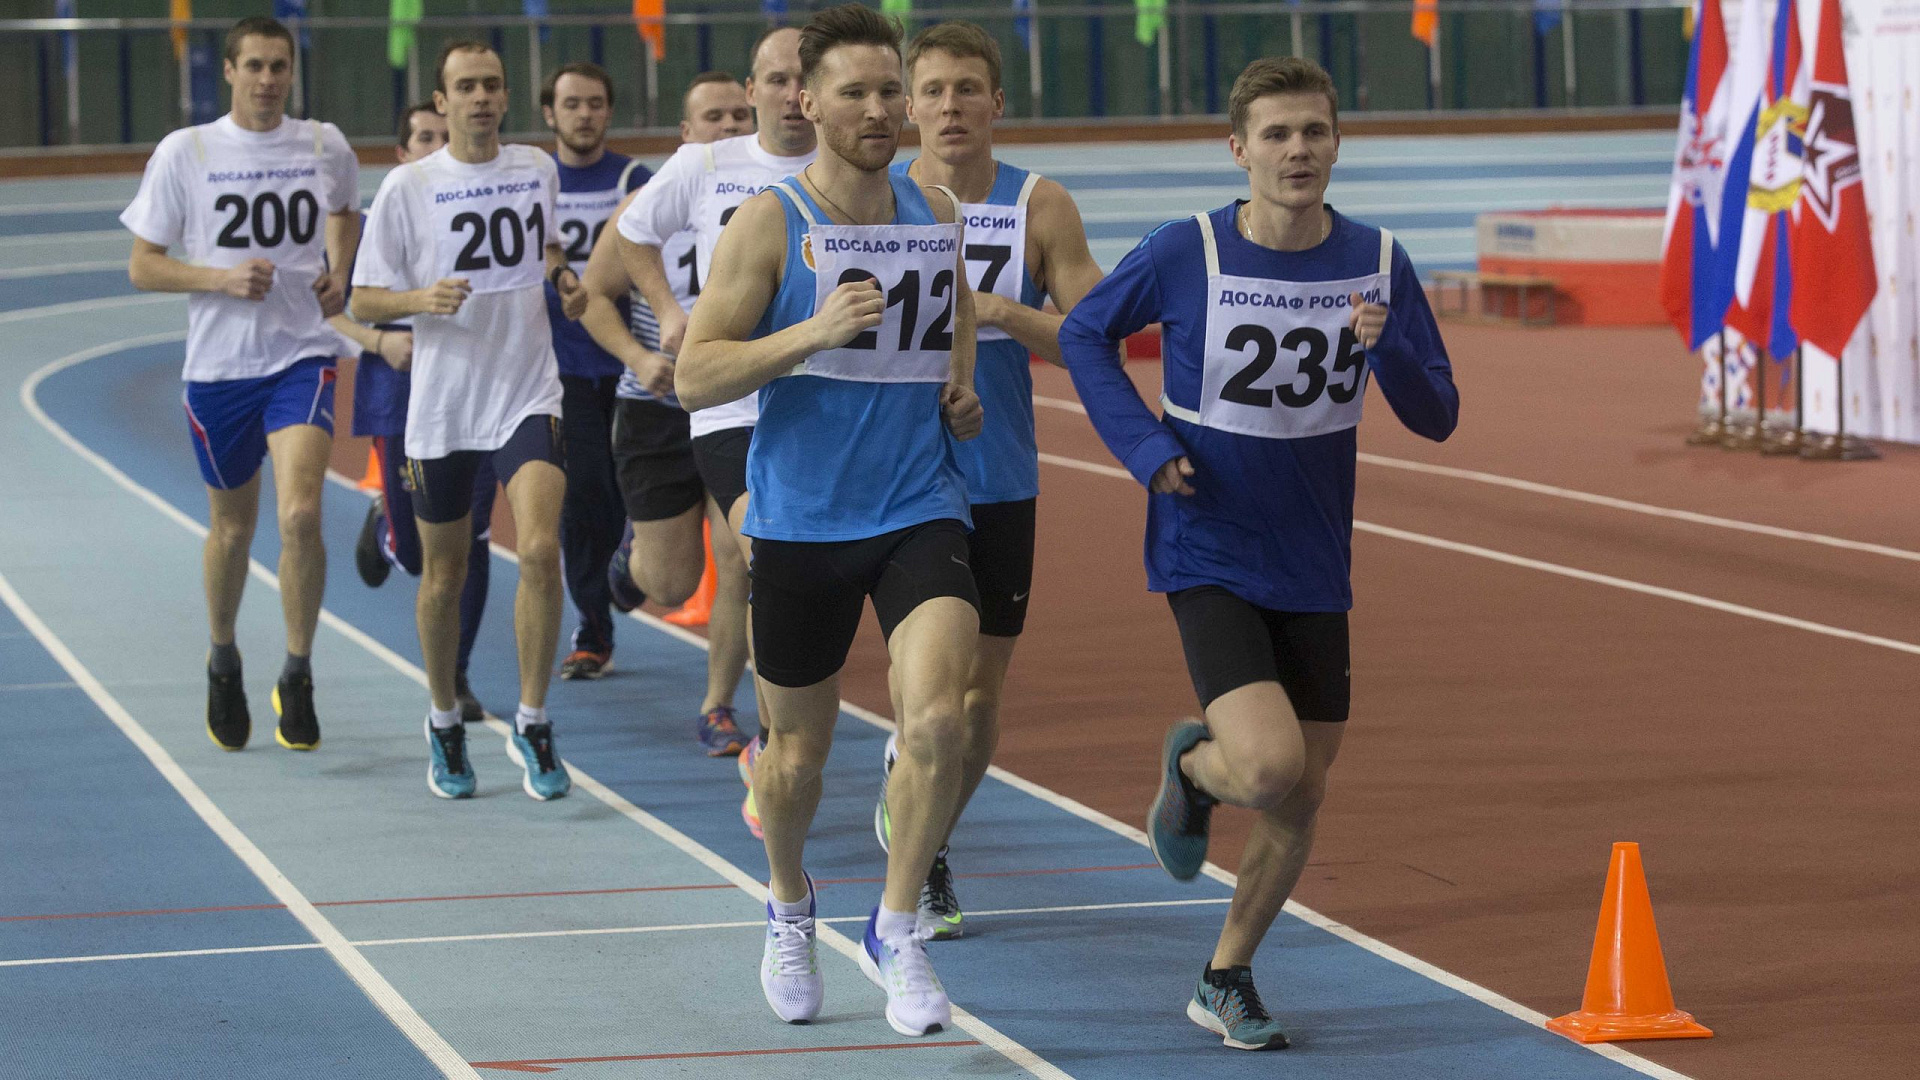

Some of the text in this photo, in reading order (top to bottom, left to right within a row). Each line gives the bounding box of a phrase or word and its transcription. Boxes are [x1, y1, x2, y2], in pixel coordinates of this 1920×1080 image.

[436, 186, 493, 203] ДОСААФ
[214, 189, 319, 248] 200
[450, 202, 544, 271] 201
[561, 218, 608, 262] 2
[825, 238, 900, 253] ДОСААФ
[1219, 290, 1304, 309] ДОСААФ
[1219, 323, 1366, 409] 235
